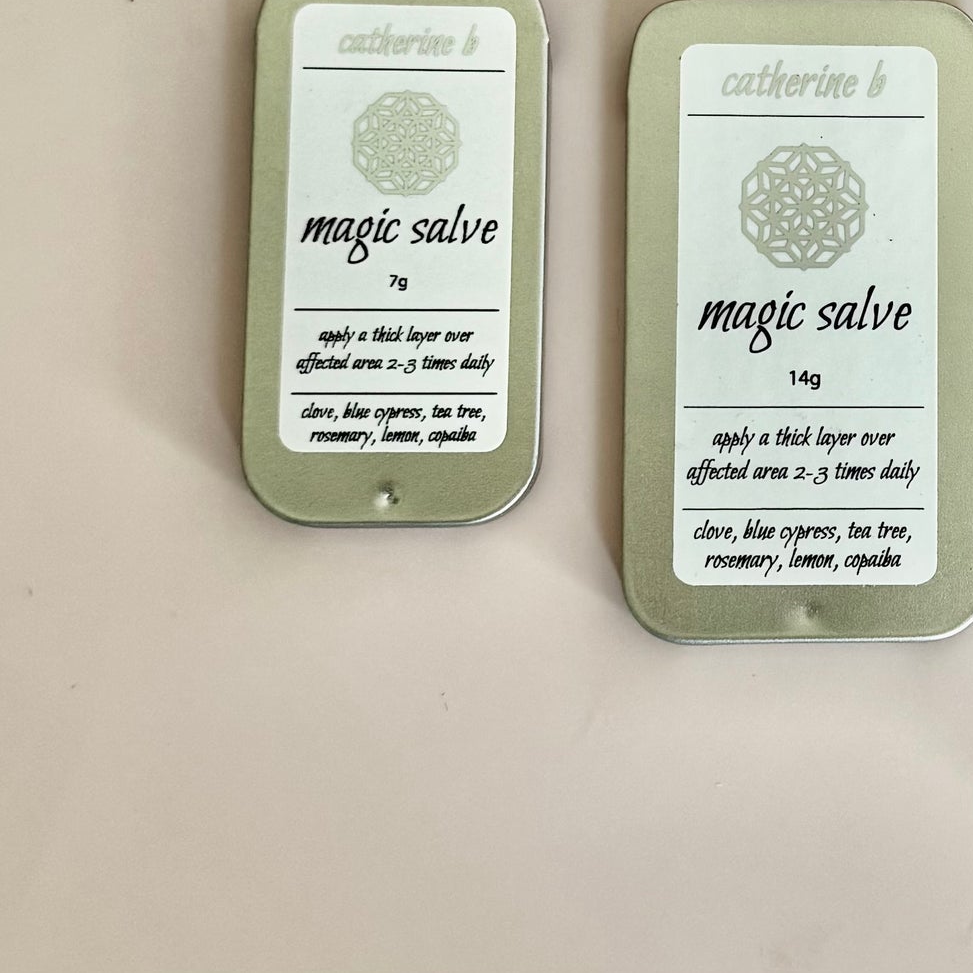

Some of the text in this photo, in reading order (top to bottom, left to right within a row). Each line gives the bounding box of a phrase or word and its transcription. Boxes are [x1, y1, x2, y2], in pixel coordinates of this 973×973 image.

[338, 22, 480, 57] catherine b
[720, 58, 887, 99] catherine b
[299, 203, 498, 264] magic salve
[389, 274, 408, 291] 7g
[697, 284, 912, 353] magic salve
[317, 325, 474, 349] apply a thick layer over
[295, 351, 495, 377] affected area 2-3 times daily
[789, 369, 820, 390] 14g
[300, 401, 486, 426] clove, blue cypress, tea tree,
[309, 424, 477, 450] rosemary, lemon, copaiba
[712, 425, 895, 455] apply a thick layer over
[686, 458, 920, 489] affected area 2-3 times daily
[693, 518, 911, 548] clove, blue cypress, tea tree,
[704, 546, 901, 577] rosemary, lemon, copaiba
